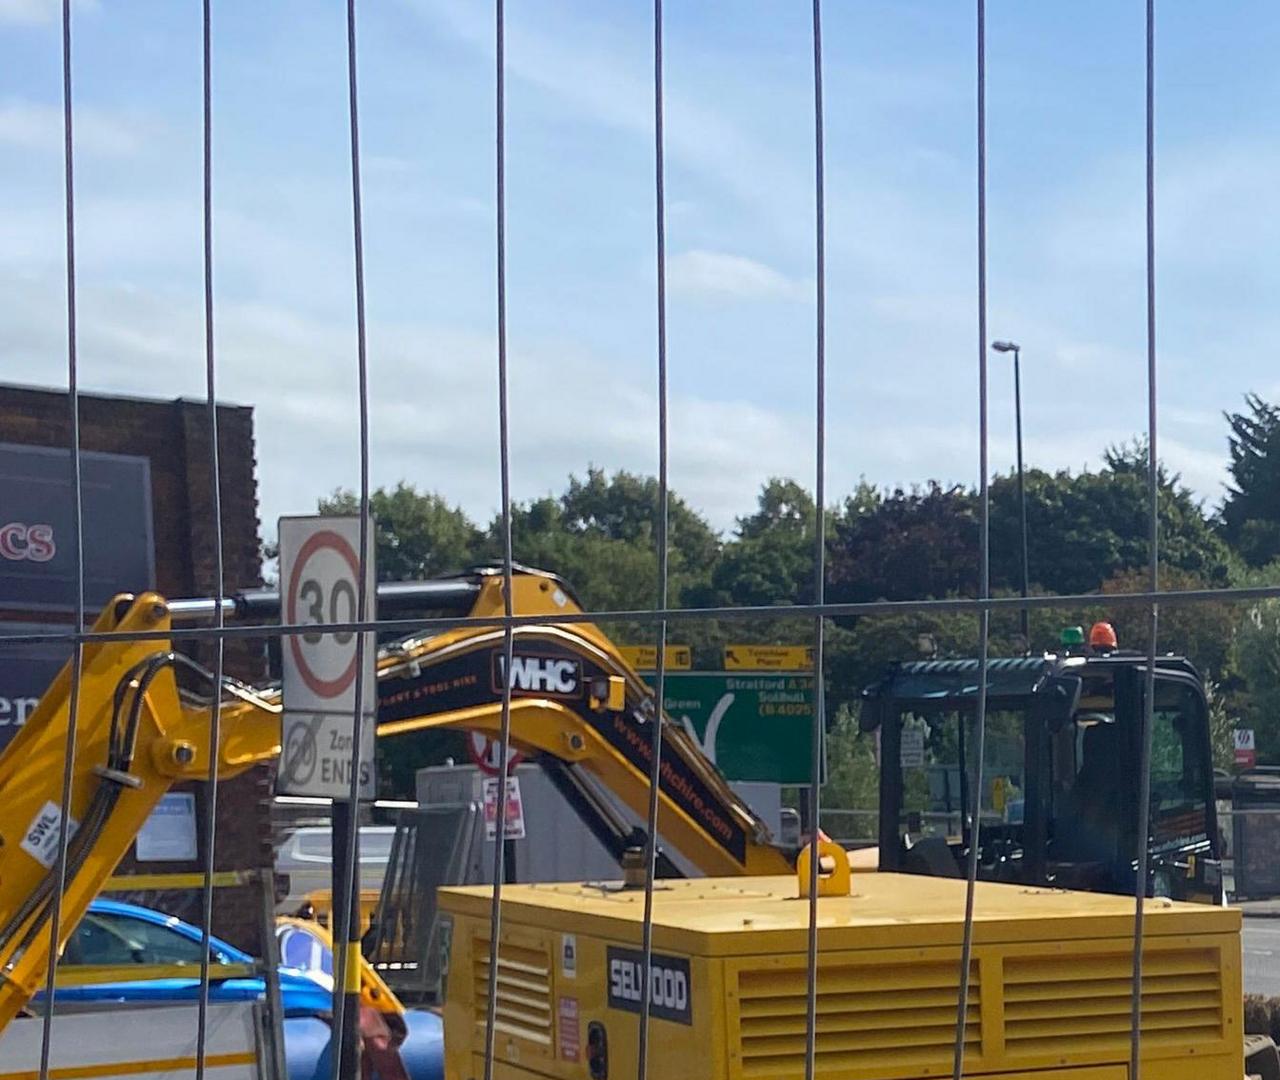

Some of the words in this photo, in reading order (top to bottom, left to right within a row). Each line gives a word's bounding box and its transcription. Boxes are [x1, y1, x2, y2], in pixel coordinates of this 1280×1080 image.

[300, 579, 356, 646] 30
[500, 656, 576, 693] WHC
[329, 729, 356, 752] Zon
